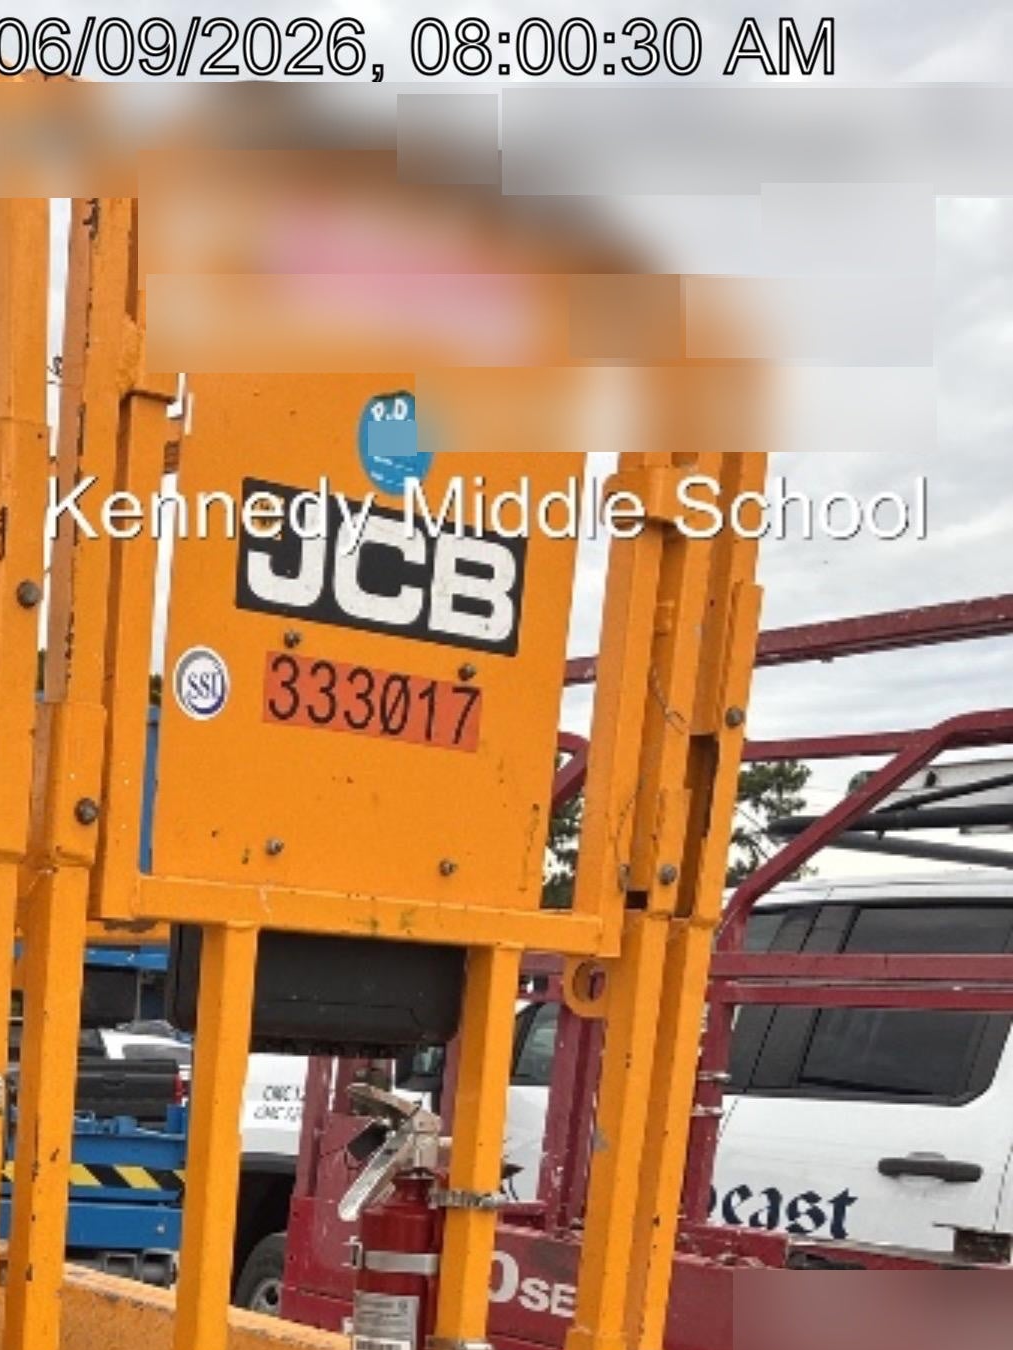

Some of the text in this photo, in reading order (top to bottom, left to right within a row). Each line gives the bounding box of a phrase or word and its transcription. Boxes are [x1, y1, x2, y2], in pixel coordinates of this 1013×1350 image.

[246, 500, 517, 642] JCB
[268, 652, 481, 745] 333017
[708, 1183, 858, 1240] east
